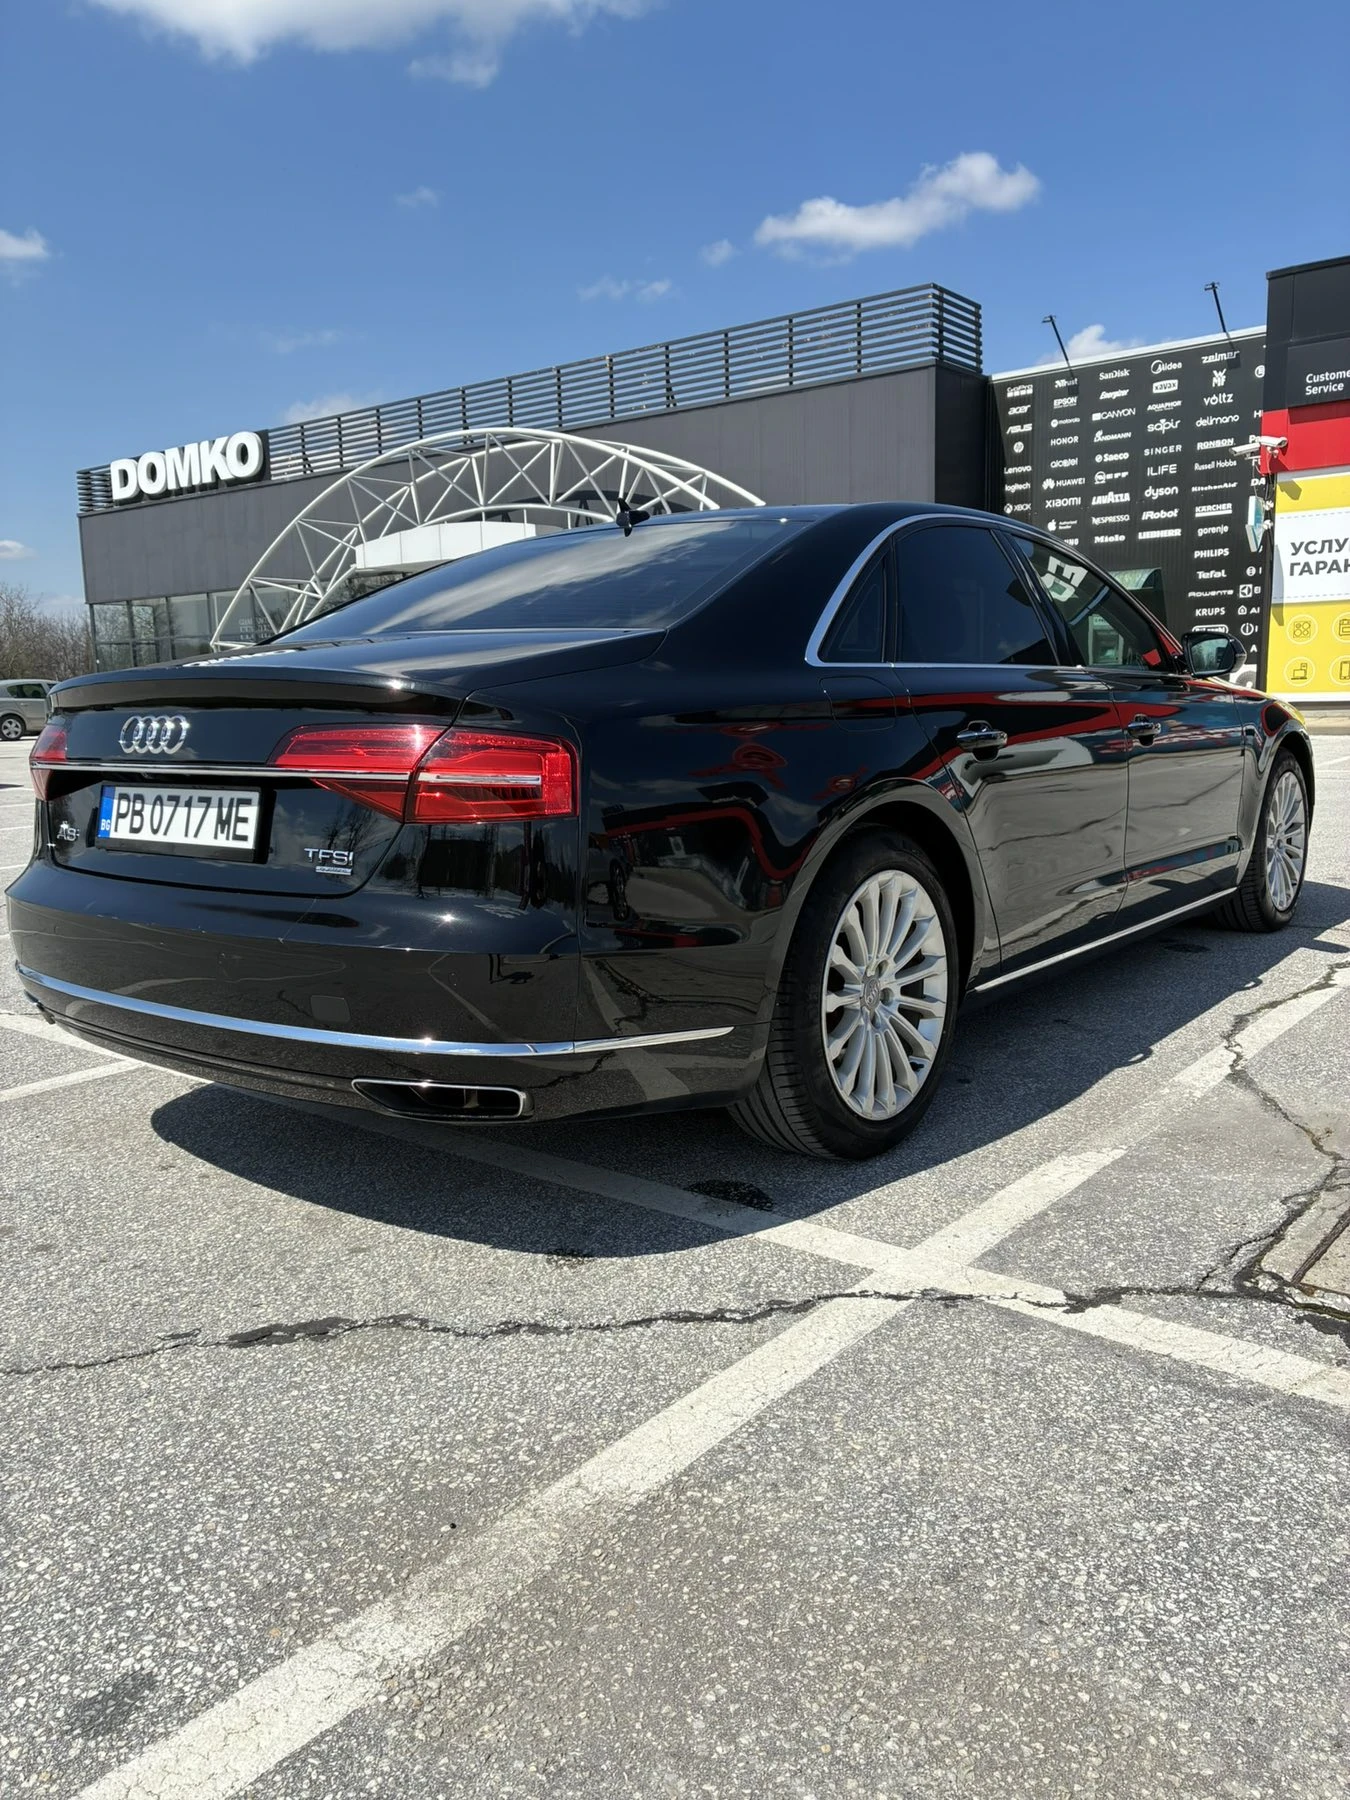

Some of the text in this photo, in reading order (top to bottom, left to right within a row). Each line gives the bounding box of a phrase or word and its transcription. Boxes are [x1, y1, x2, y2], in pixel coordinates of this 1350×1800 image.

[1099, 369, 1130, 380] SanDisk
[1305, 382, 1345, 396] Service
[1054, 396, 1078, 407] EPSON
[1008, 405, 1031, 415] acer
[1101, 408, 1136, 419] CANYON
[1006, 423, 1032, 434] ASUS
[1051, 436, 1079, 446] HONOR
[1144, 445, 1182, 456] SINGER
[1104, 452, 1129, 462] Saeco
[110, 431, 264, 501] DOMKO
[1004, 465, 1032, 474] Lenovo
[1147, 464, 1177, 476] ILIFE
[1194, 459, 1238, 472] Russell Hobbs
[1005, 481, 1030, 494] logitech
[1056, 478, 1085, 488] HUAWEI
[1091, 491, 1130, 505] LAVAZZA
[1144, 485, 1178, 500] dyson
[1014, 503, 1032, 512] XBOX
[1138, 527, 1182, 540] LIEBHERR
[1197, 524, 1229, 537] gorenje
[1290, 537, 1350, 556] УСЛУ
[1194, 548, 1230, 559] PHILIPS
[1196, 569, 1228, 580] Tefal
[1195, 607, 1226, 617] KRUPS
[113, 791, 252, 842] PB 0717 ME
[100, 818, 111, 831] BG
[304, 848, 354, 867] TFSI
